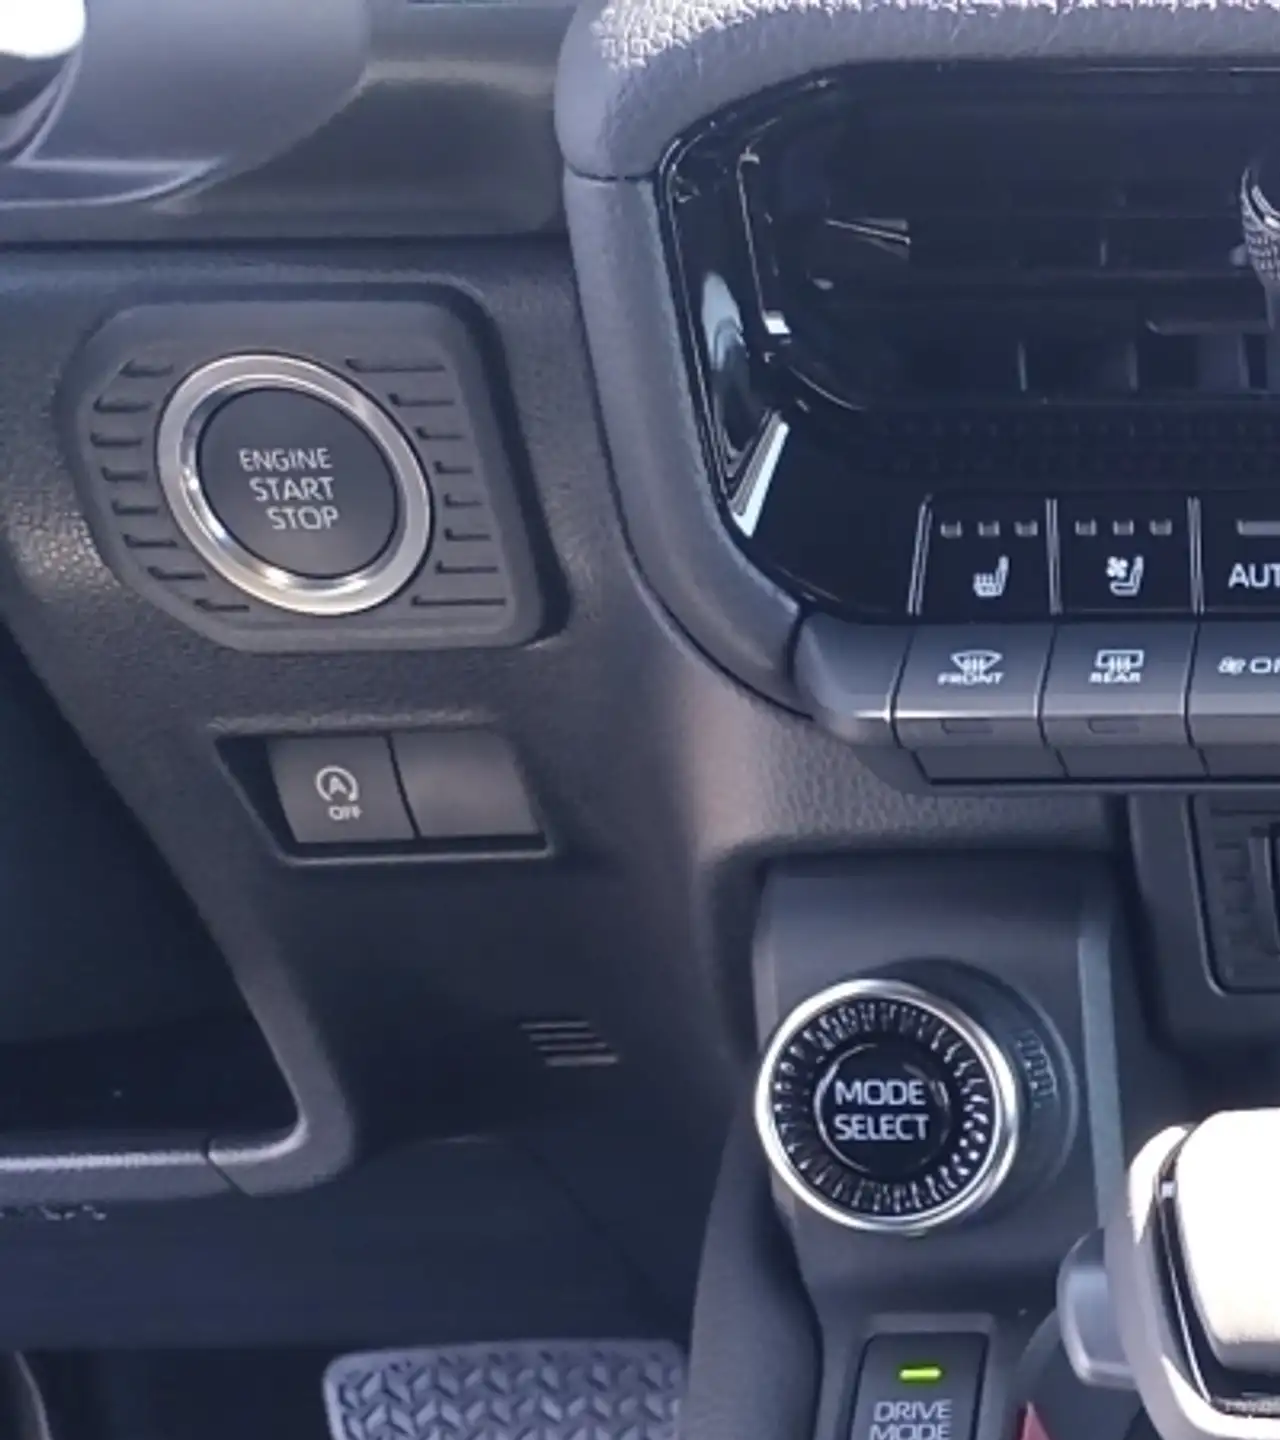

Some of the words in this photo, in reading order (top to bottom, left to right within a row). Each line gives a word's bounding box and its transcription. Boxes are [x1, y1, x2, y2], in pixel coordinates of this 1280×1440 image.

[240, 448, 333, 472] ENGINE
[249, 476, 335, 501] START
[266, 506, 339, 530] STOP
[937, 672, 1003, 685] FRONT
[1089, 673, 1142, 684] REAR
[328, 805, 362, 820] OFF
[834, 1080, 926, 1104] MODE
[834, 1116, 929, 1141] SELECT
[873, 1402, 952, 1422] DRIVE
